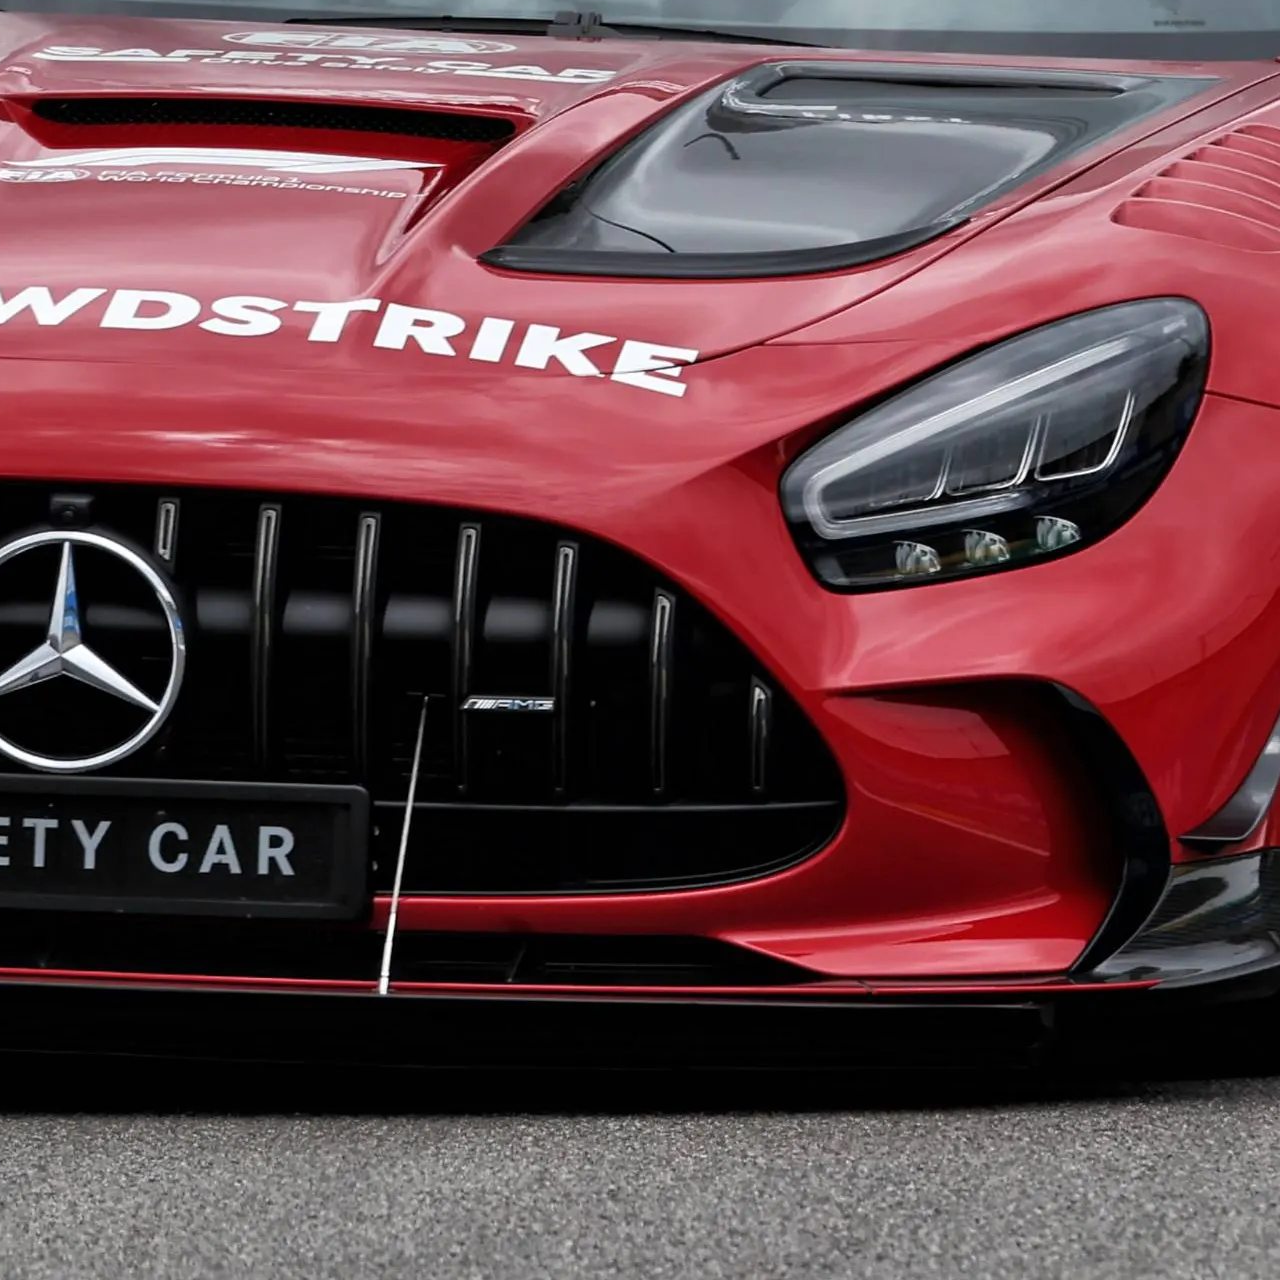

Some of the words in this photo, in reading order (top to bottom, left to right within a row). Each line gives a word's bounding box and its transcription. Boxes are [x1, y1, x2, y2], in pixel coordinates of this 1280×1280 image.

[239, 31, 478, 55] FIA
[41, 45, 407, 65] SAFETY
[426, 60, 619, 81] CAR
[199, 56, 309, 67] Drive
[319, 61, 449, 75] Safely
[3, 169, 76, 182] FIA
[96, 173, 188, 183] World
[191, 176, 408, 199] Championship
[99, 169, 149, 178] FIA
[154, 170, 281, 182] Formula
[493, 697, 555, 712] AMG
[148, 822, 294, 876] CAR
